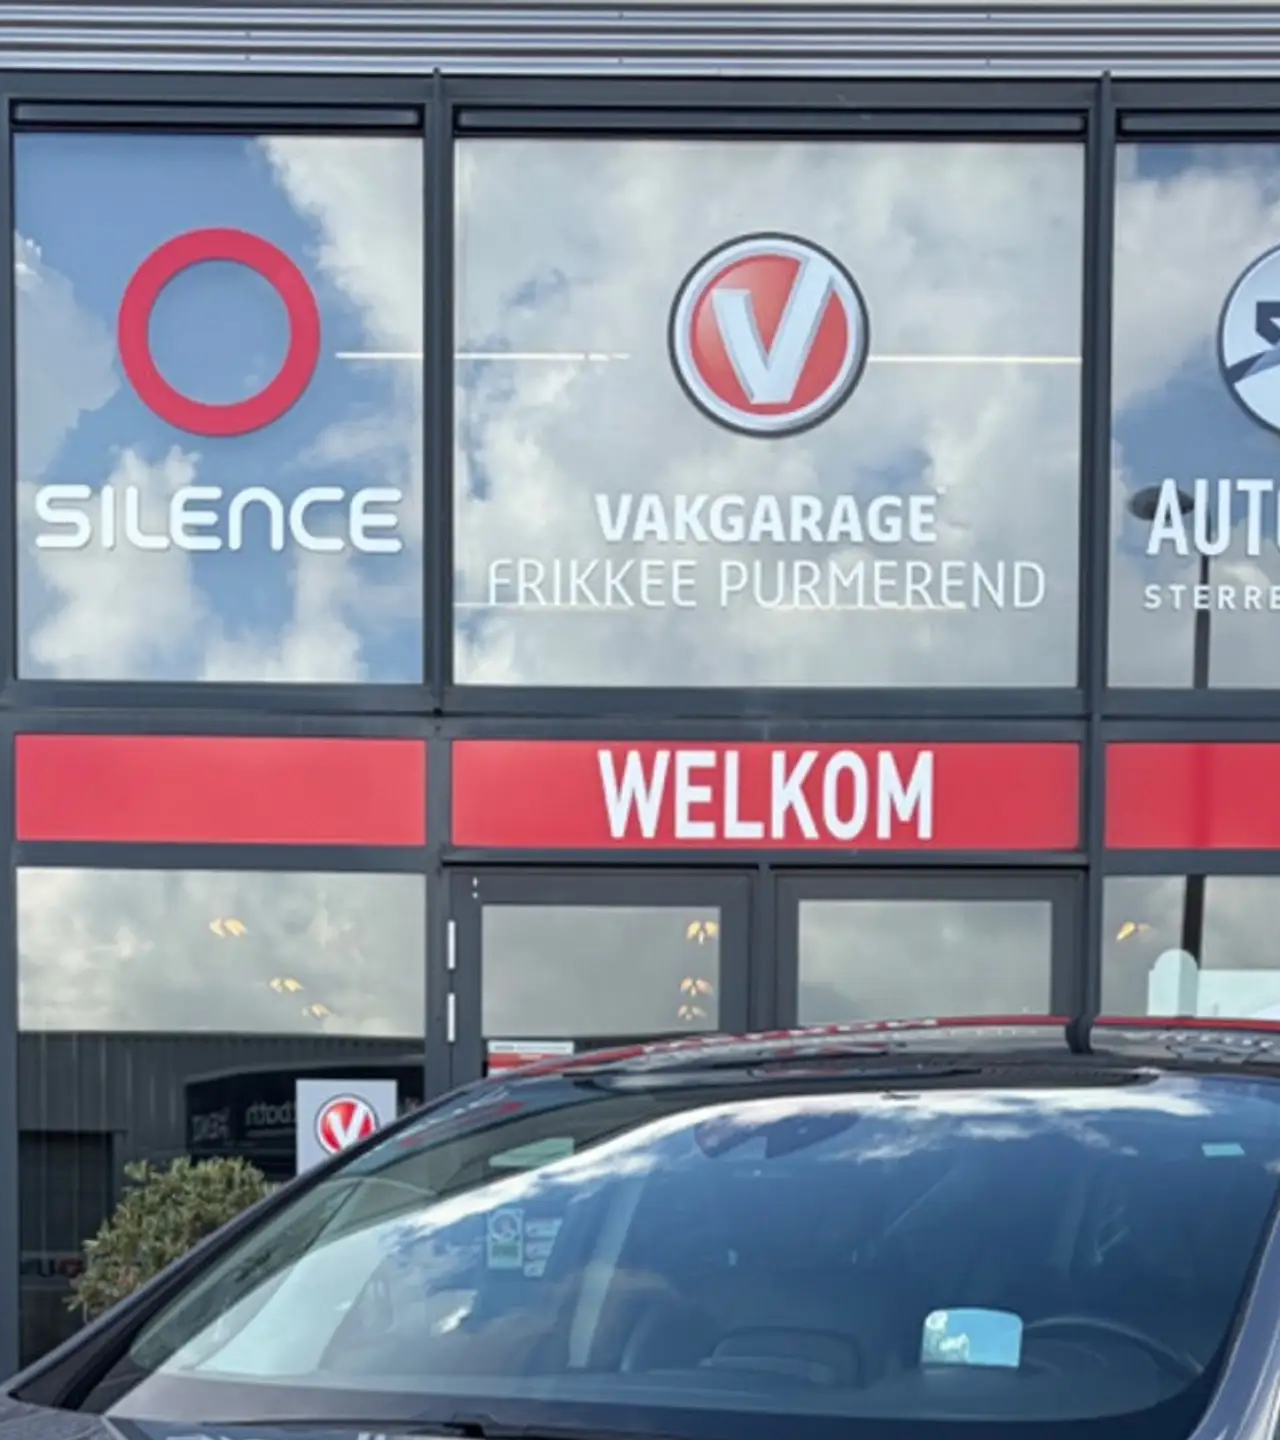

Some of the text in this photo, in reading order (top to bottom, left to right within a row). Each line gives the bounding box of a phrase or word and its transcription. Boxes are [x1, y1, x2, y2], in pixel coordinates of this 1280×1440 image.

[35, 484, 403, 553] SILENCE
[595, 493, 938, 543] VAKGARAGE
[488, 559, 1046, 609] FRIKKEE PURMEREND
[598, 749, 934, 840] WELKOM
